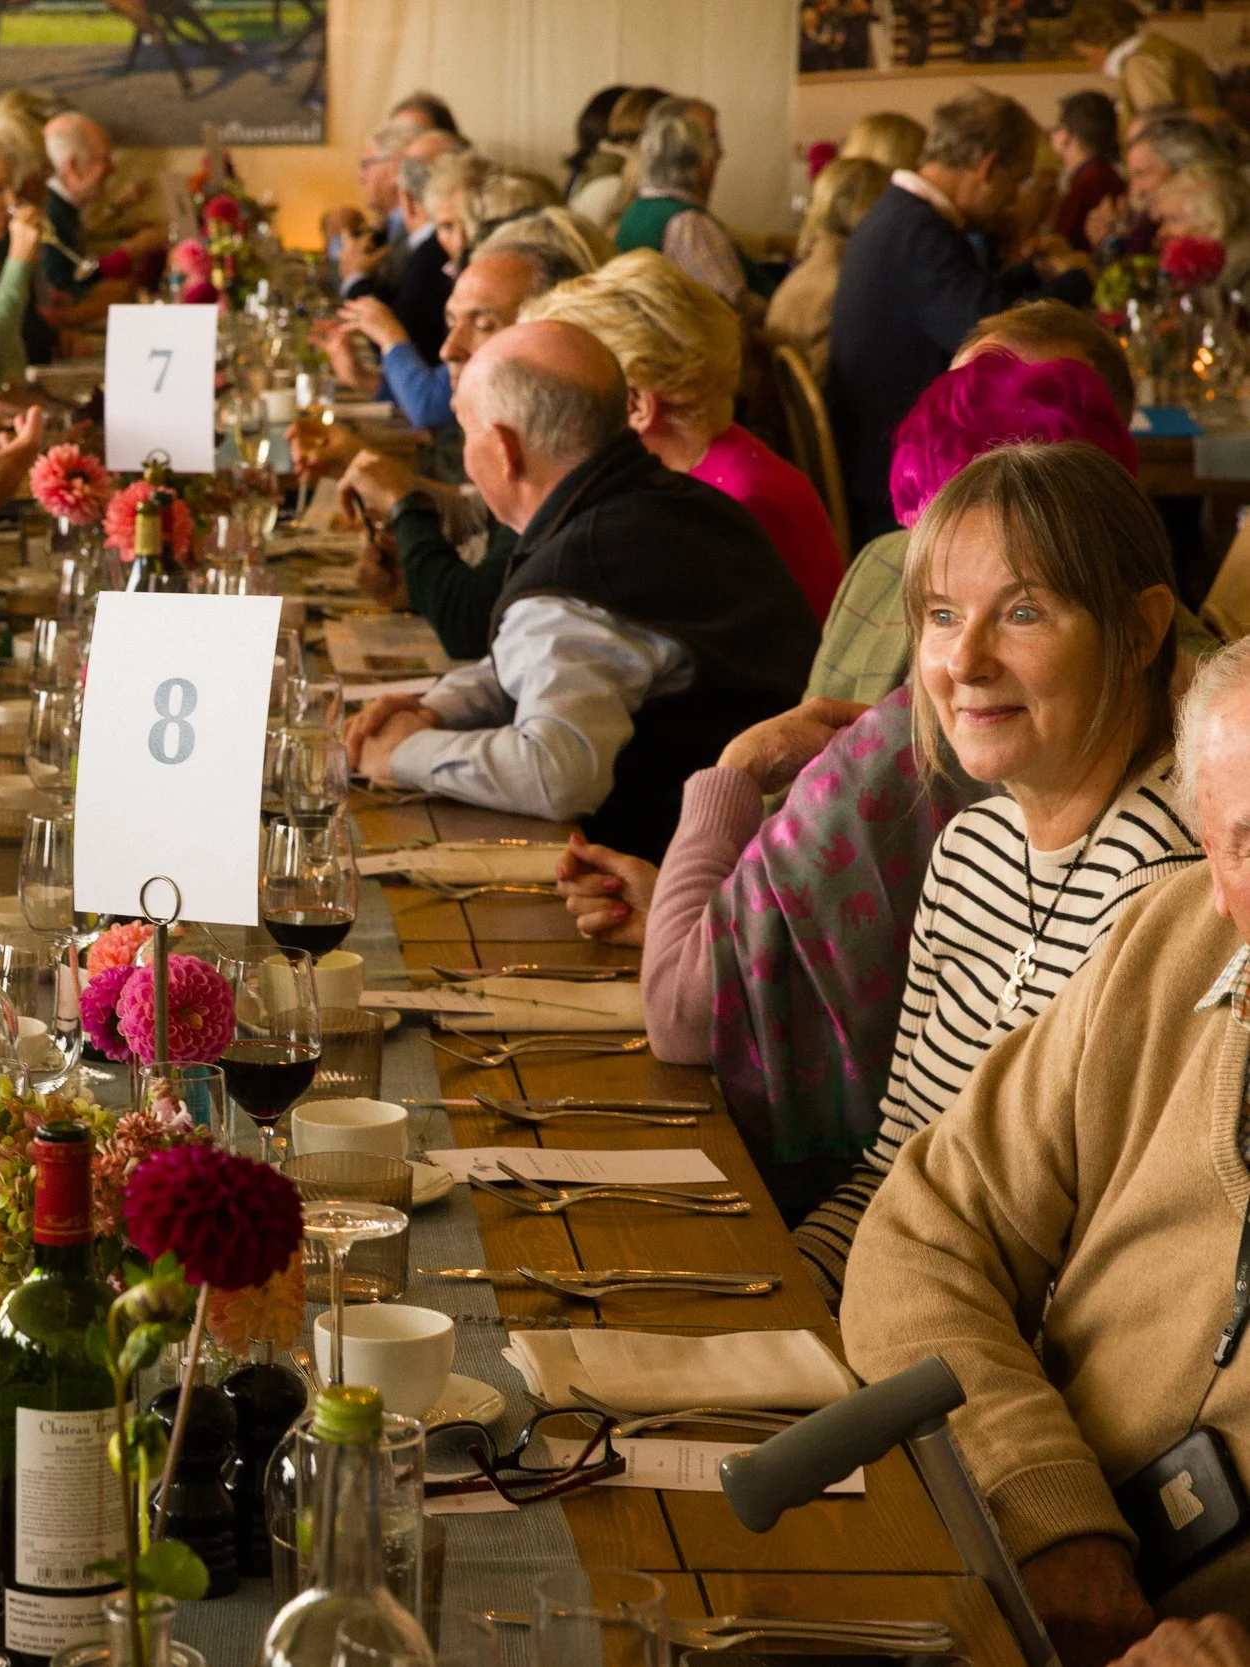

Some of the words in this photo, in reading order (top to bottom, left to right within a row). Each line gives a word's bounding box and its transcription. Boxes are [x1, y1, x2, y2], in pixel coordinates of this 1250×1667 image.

[148, 347, 174, 394] 7
[147, 676, 199, 766] 8
[39, 1419, 90, 1435] Château
